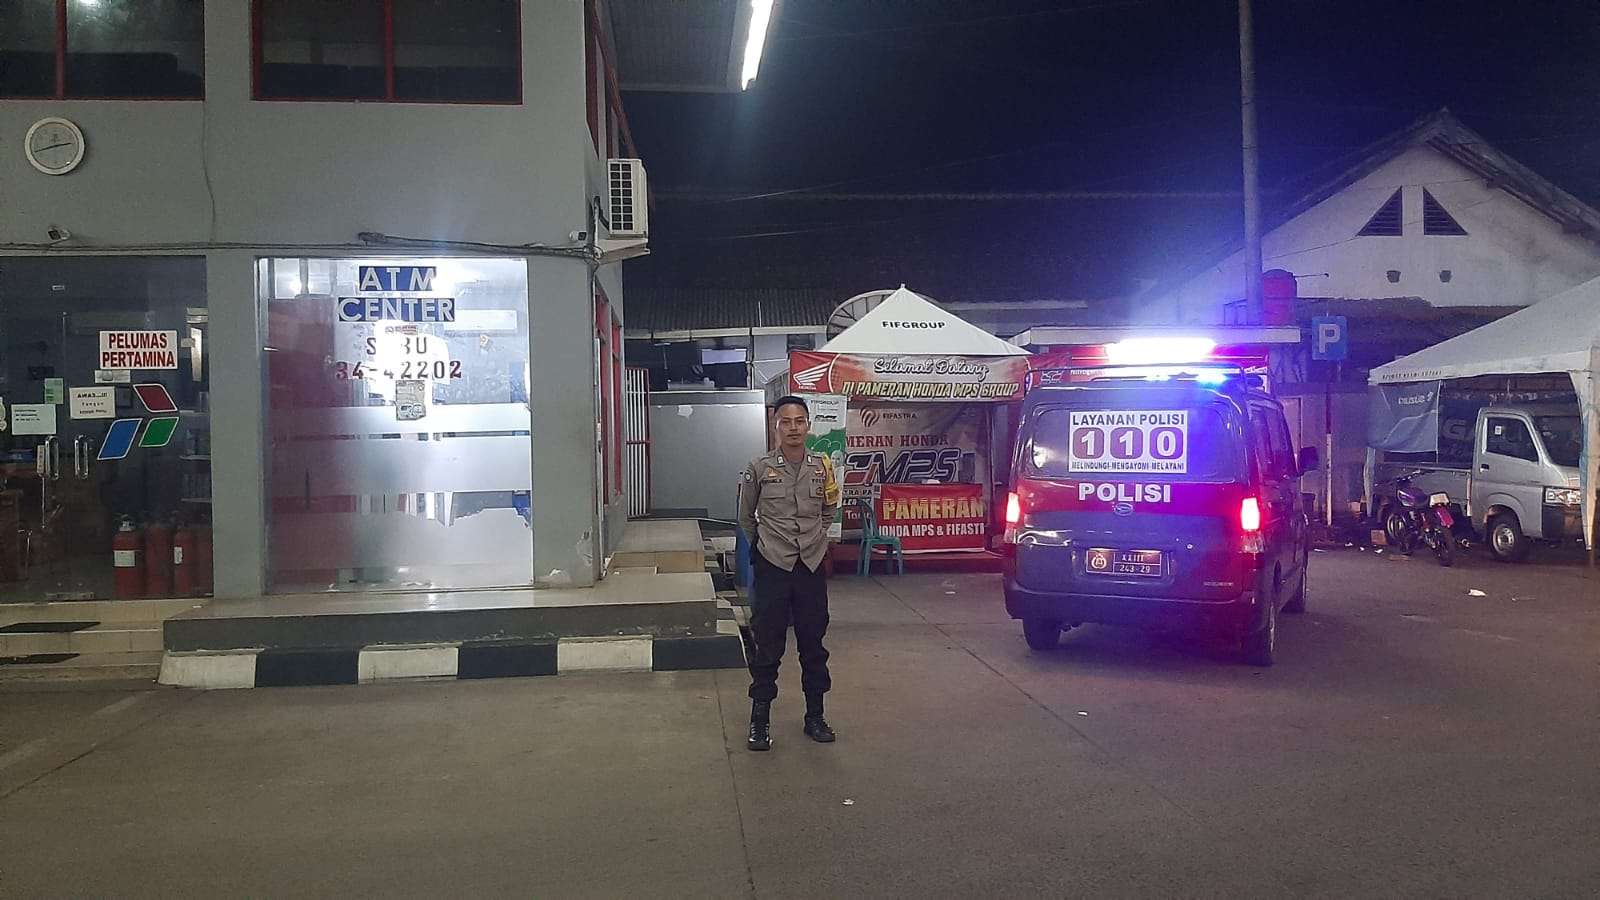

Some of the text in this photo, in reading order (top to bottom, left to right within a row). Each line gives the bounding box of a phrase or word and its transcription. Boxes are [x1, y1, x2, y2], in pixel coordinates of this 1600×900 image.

[361, 267, 433, 290] ATM
[338, 298, 454, 321] CENTER
[882, 321, 946, 329] FIFGROUP
[109, 333, 168, 349] PELUMAS
[1319, 323, 1340, 353] P
[102, 351, 175, 367] PERTAMINA
[874, 359, 989, 381] Selamat Datang
[856, 382, 912, 398] PAMERAN
[914, 382, 950, 398] HONDA
[953, 382, 980, 398] MPS
[980, 382, 1019, 398] GROUP
[1072, 414, 1185, 425] LAYANAN POLISI
[845, 434, 949, 448] MERAN HONDA
[1078, 483, 1171, 503] POLISI
[883, 498, 984, 520] PAMERAN
[911, 524, 935, 537] MPS
[936, 525, 944, 536] &
[945, 522, 985, 536] FIFASTR
